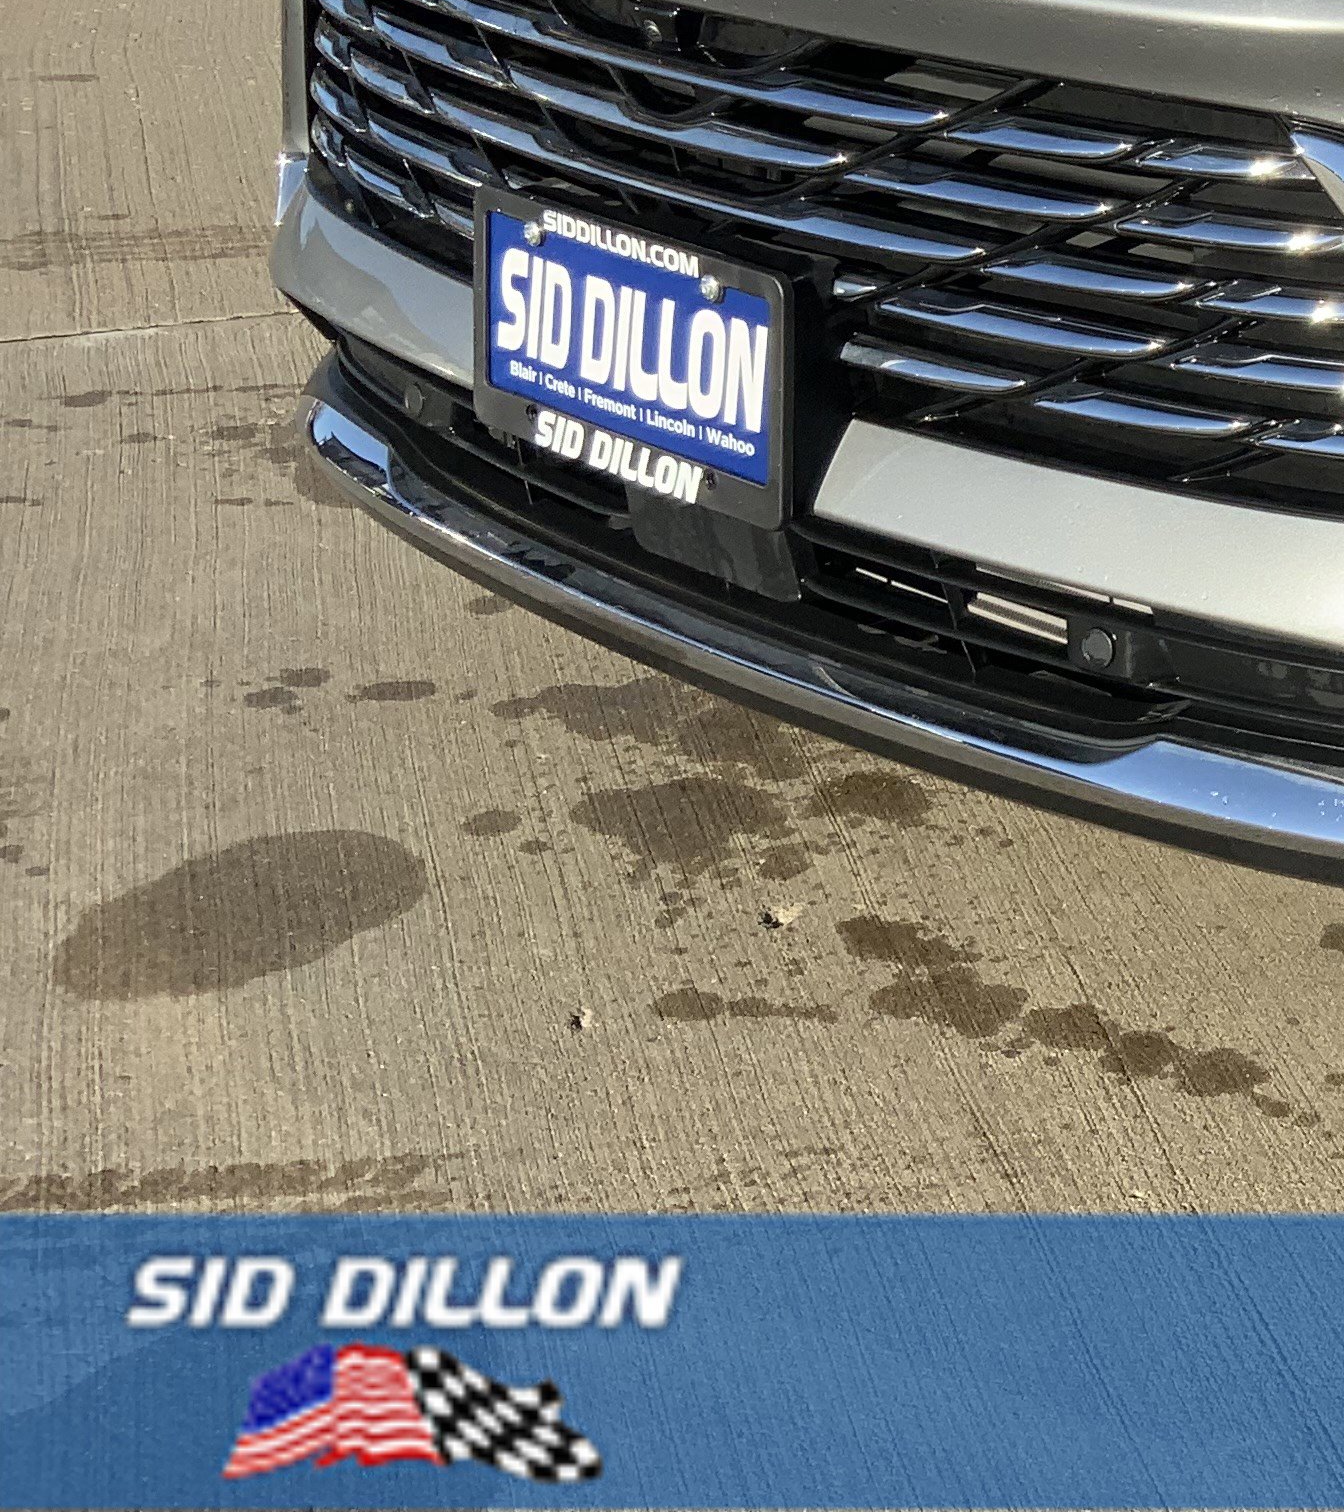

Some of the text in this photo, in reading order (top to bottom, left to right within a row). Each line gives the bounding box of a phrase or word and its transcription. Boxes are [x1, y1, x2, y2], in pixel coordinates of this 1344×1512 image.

[543, 210, 700, 279] SIDDILLON.COM
[497, 247, 769, 434] SID DILLON
[509, 360, 756, 457] Blair Crete Fremont Lincoln Wahoo
[534, 410, 703, 505] SID DILLON
